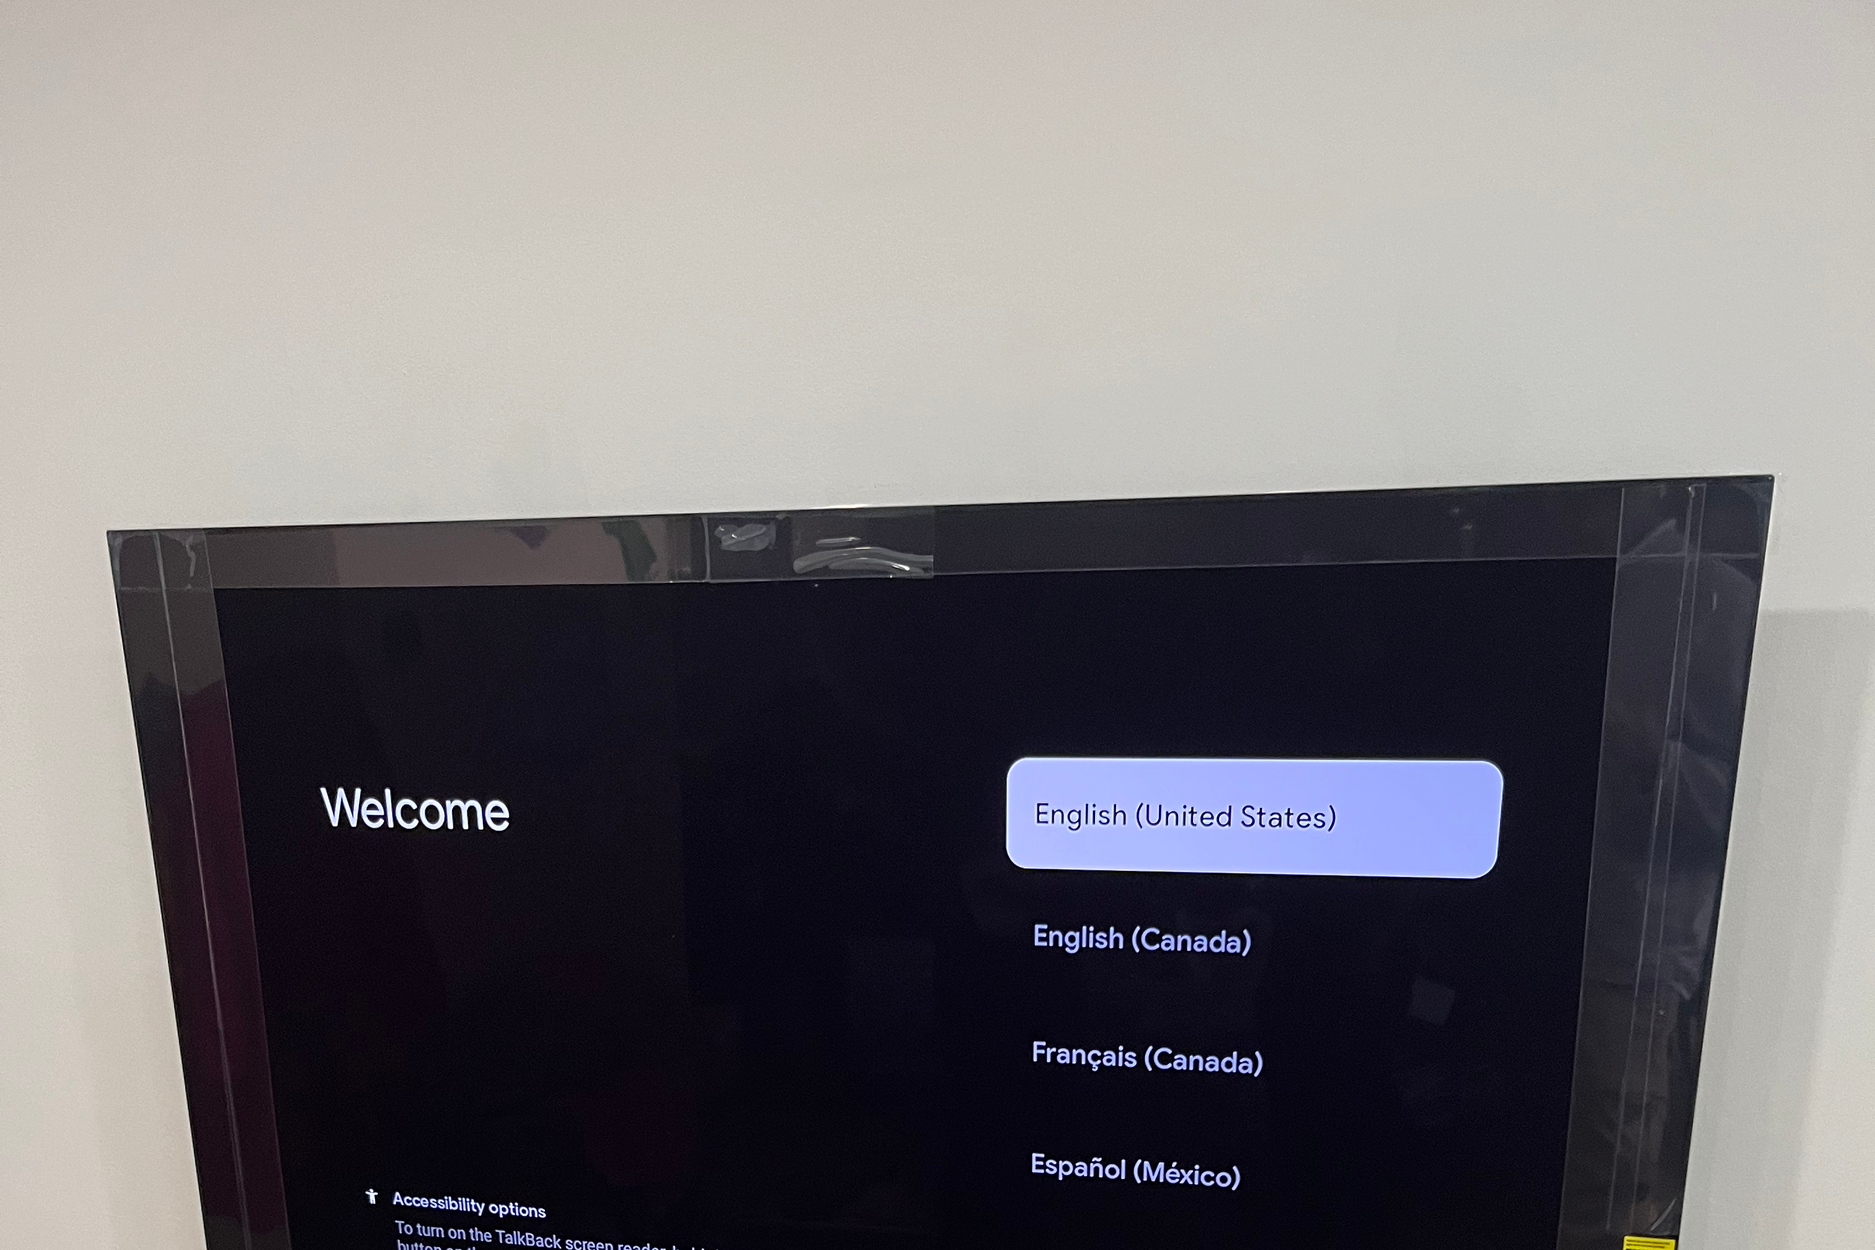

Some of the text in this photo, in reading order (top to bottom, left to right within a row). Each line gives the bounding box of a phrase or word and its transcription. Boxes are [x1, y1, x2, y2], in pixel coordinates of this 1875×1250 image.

[319, 786, 510, 832] Welcome
[1036, 802, 1336, 832] English (United States)
[1034, 923, 1252, 957] English (Canada)
[1032, 1040, 1264, 1078] Français (Canada)
[1031, 1152, 1241, 1191] Español (México)
[392, 1191, 547, 1219] Accessibility options
[394, 1219, 414, 1236] To
[415, 1222, 445, 1238] turn
[447, 1227, 467, 1241] on
[468, 1226, 493, 1243] the
[494, 1229, 562, 1250] TalkBack
